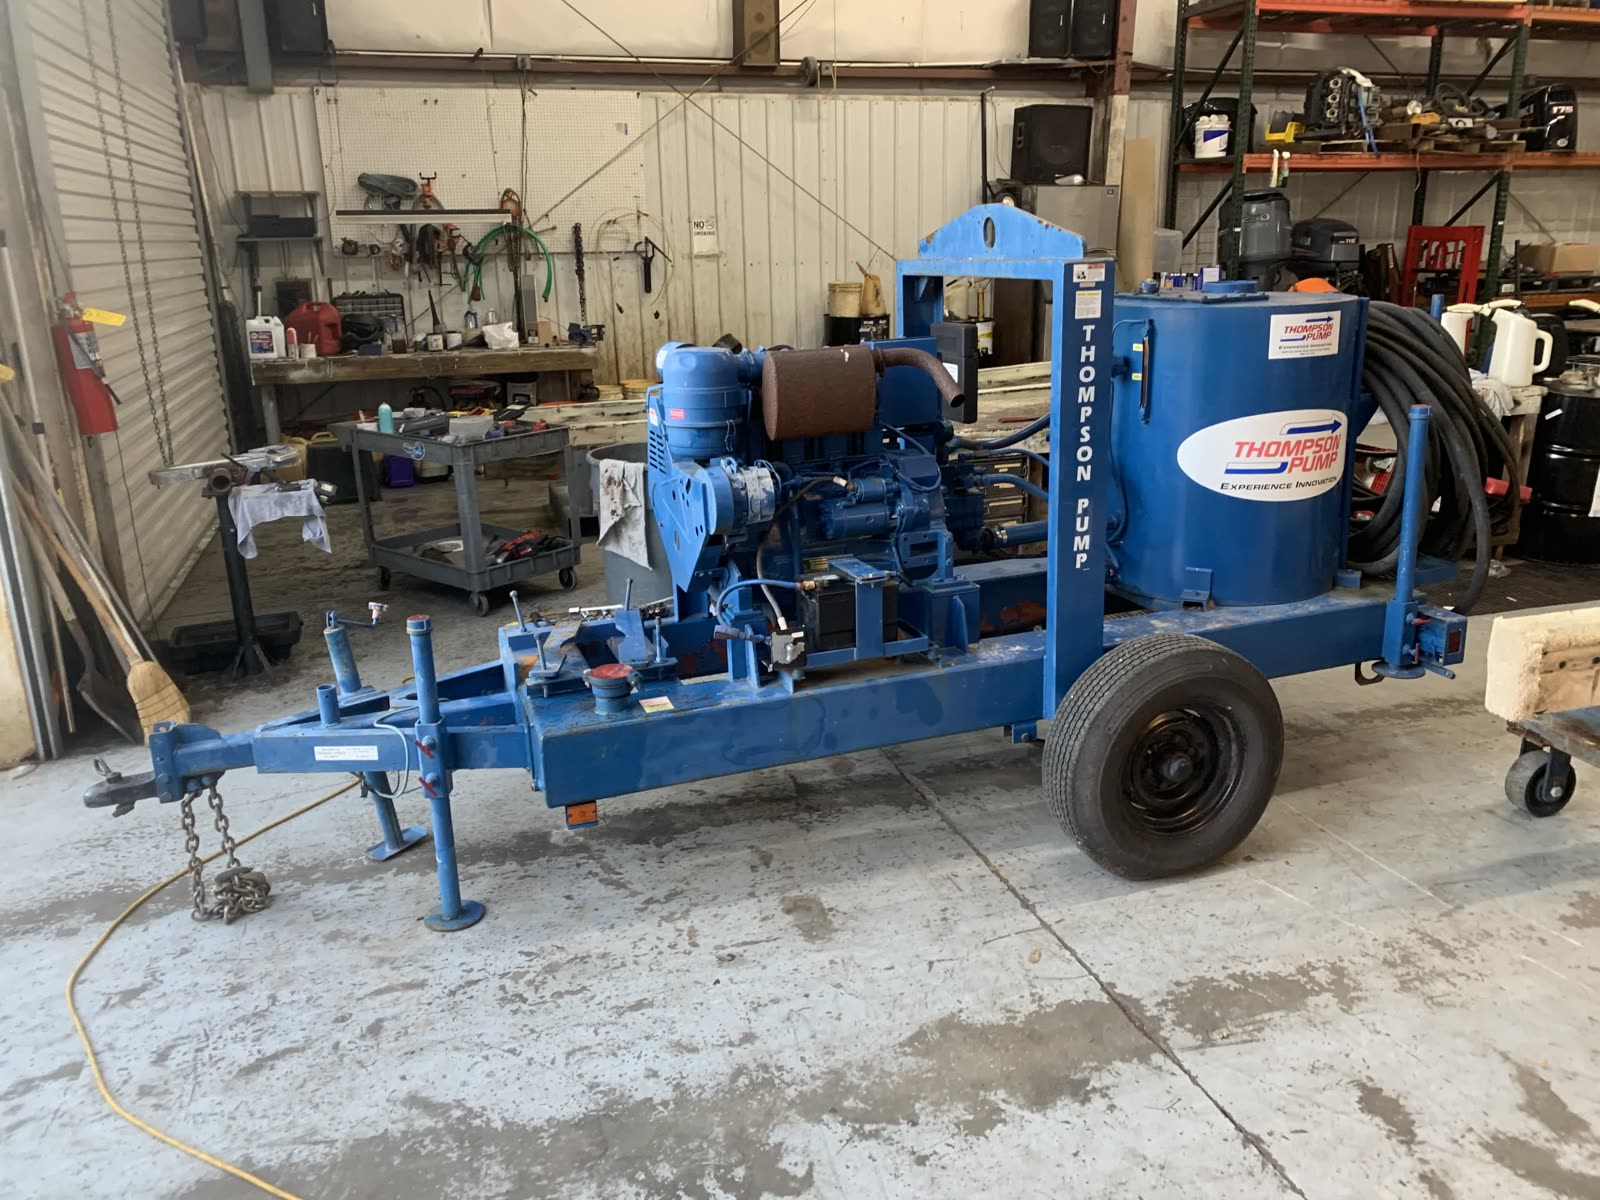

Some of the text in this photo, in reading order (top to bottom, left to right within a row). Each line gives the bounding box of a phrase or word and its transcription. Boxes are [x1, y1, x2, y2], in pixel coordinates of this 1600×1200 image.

[1552, 105, 1574, 114] 175
[693, 220, 705, 229] NO
[1284, 323, 1334, 334] THOMPSON
[1306, 331, 1332, 341] PUMP
[1076, 325, 1096, 482] THOMPSON
[1235, 434, 1342, 458] THOMPSON
[1287, 451, 1338, 474] PUMP
[1220, 475, 1338, 490] EXPERIENCE INNOVATION
[1073, 498, 1090, 569] PUMP
